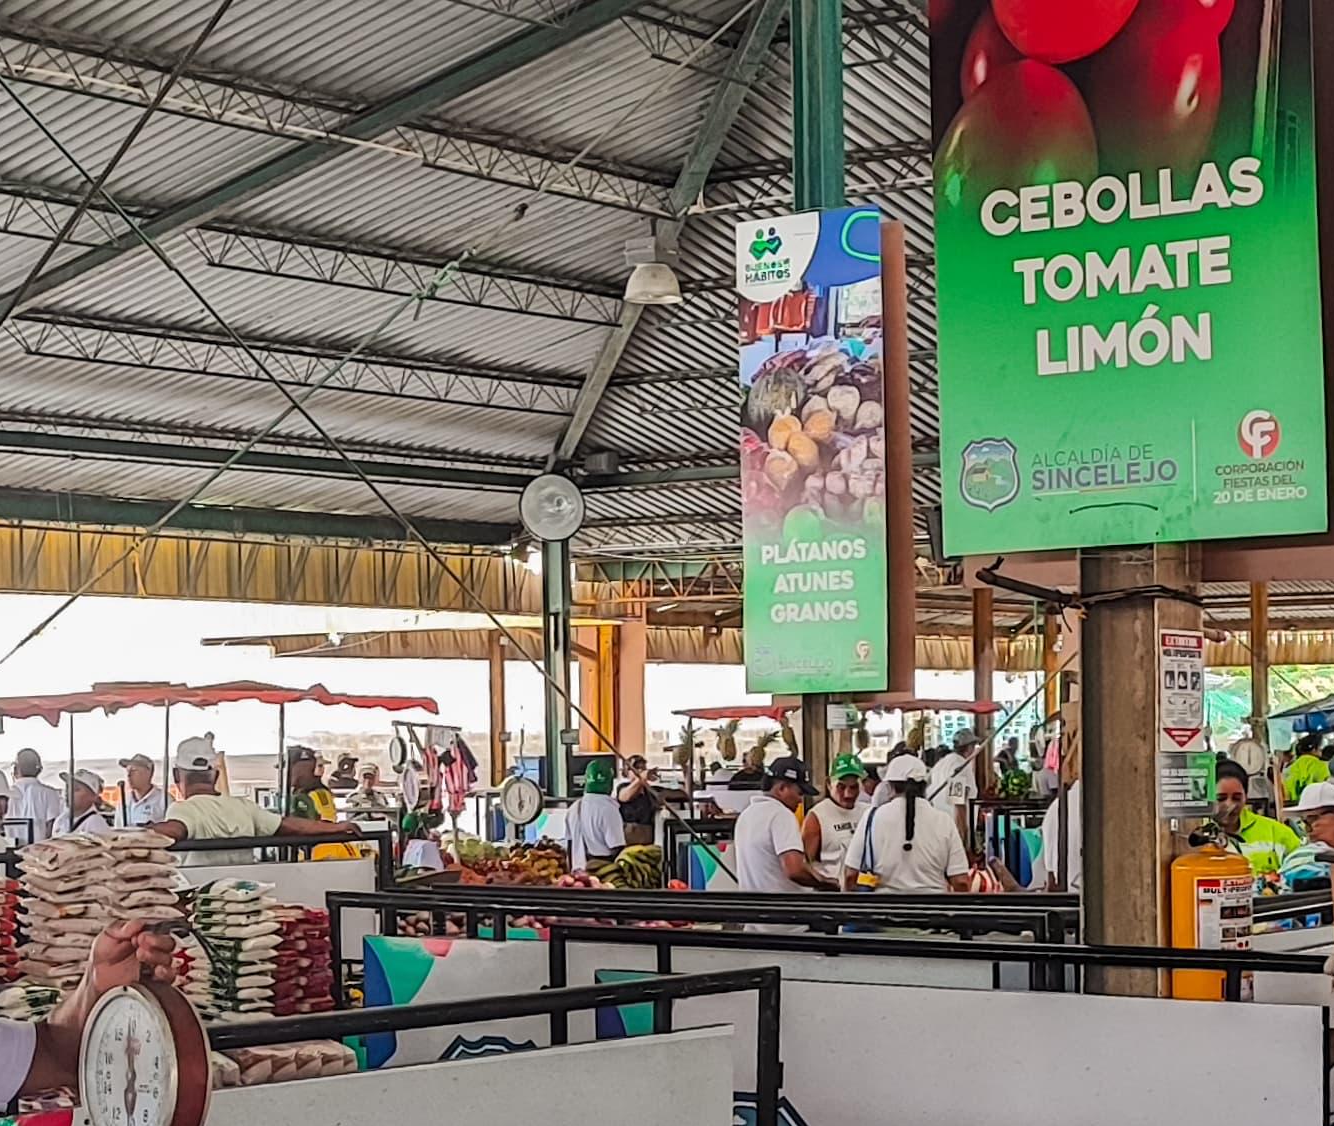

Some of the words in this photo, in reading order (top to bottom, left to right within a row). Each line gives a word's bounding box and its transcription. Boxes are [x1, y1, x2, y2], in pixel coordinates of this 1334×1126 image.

[980, 157, 1264, 237] CEBOLLAS
[1013, 236, 1232, 305] TOMATE
[1036, 303, 1212, 376] LIMÓN
[1031, 443, 1122, 468] ALCALDÍA
[1128, 444, 1153, 461] DE
[1215, 459, 1304, 476] CORPORACIÓN
[1032, 459, 1178, 491] SINCELEJO
[1223, 475, 1269, 489] FIESTAS
[1272, 474, 1296, 486] DEL
[1213, 490, 1231, 504] 20
[1233, 488, 1255, 502] DE
[1256, 486, 1308, 501] ENERO
[761, 538, 867, 565] PLÁTANOS
[773, 570, 855, 594] ATUNES
[770, 600, 859, 623] GRANOS
